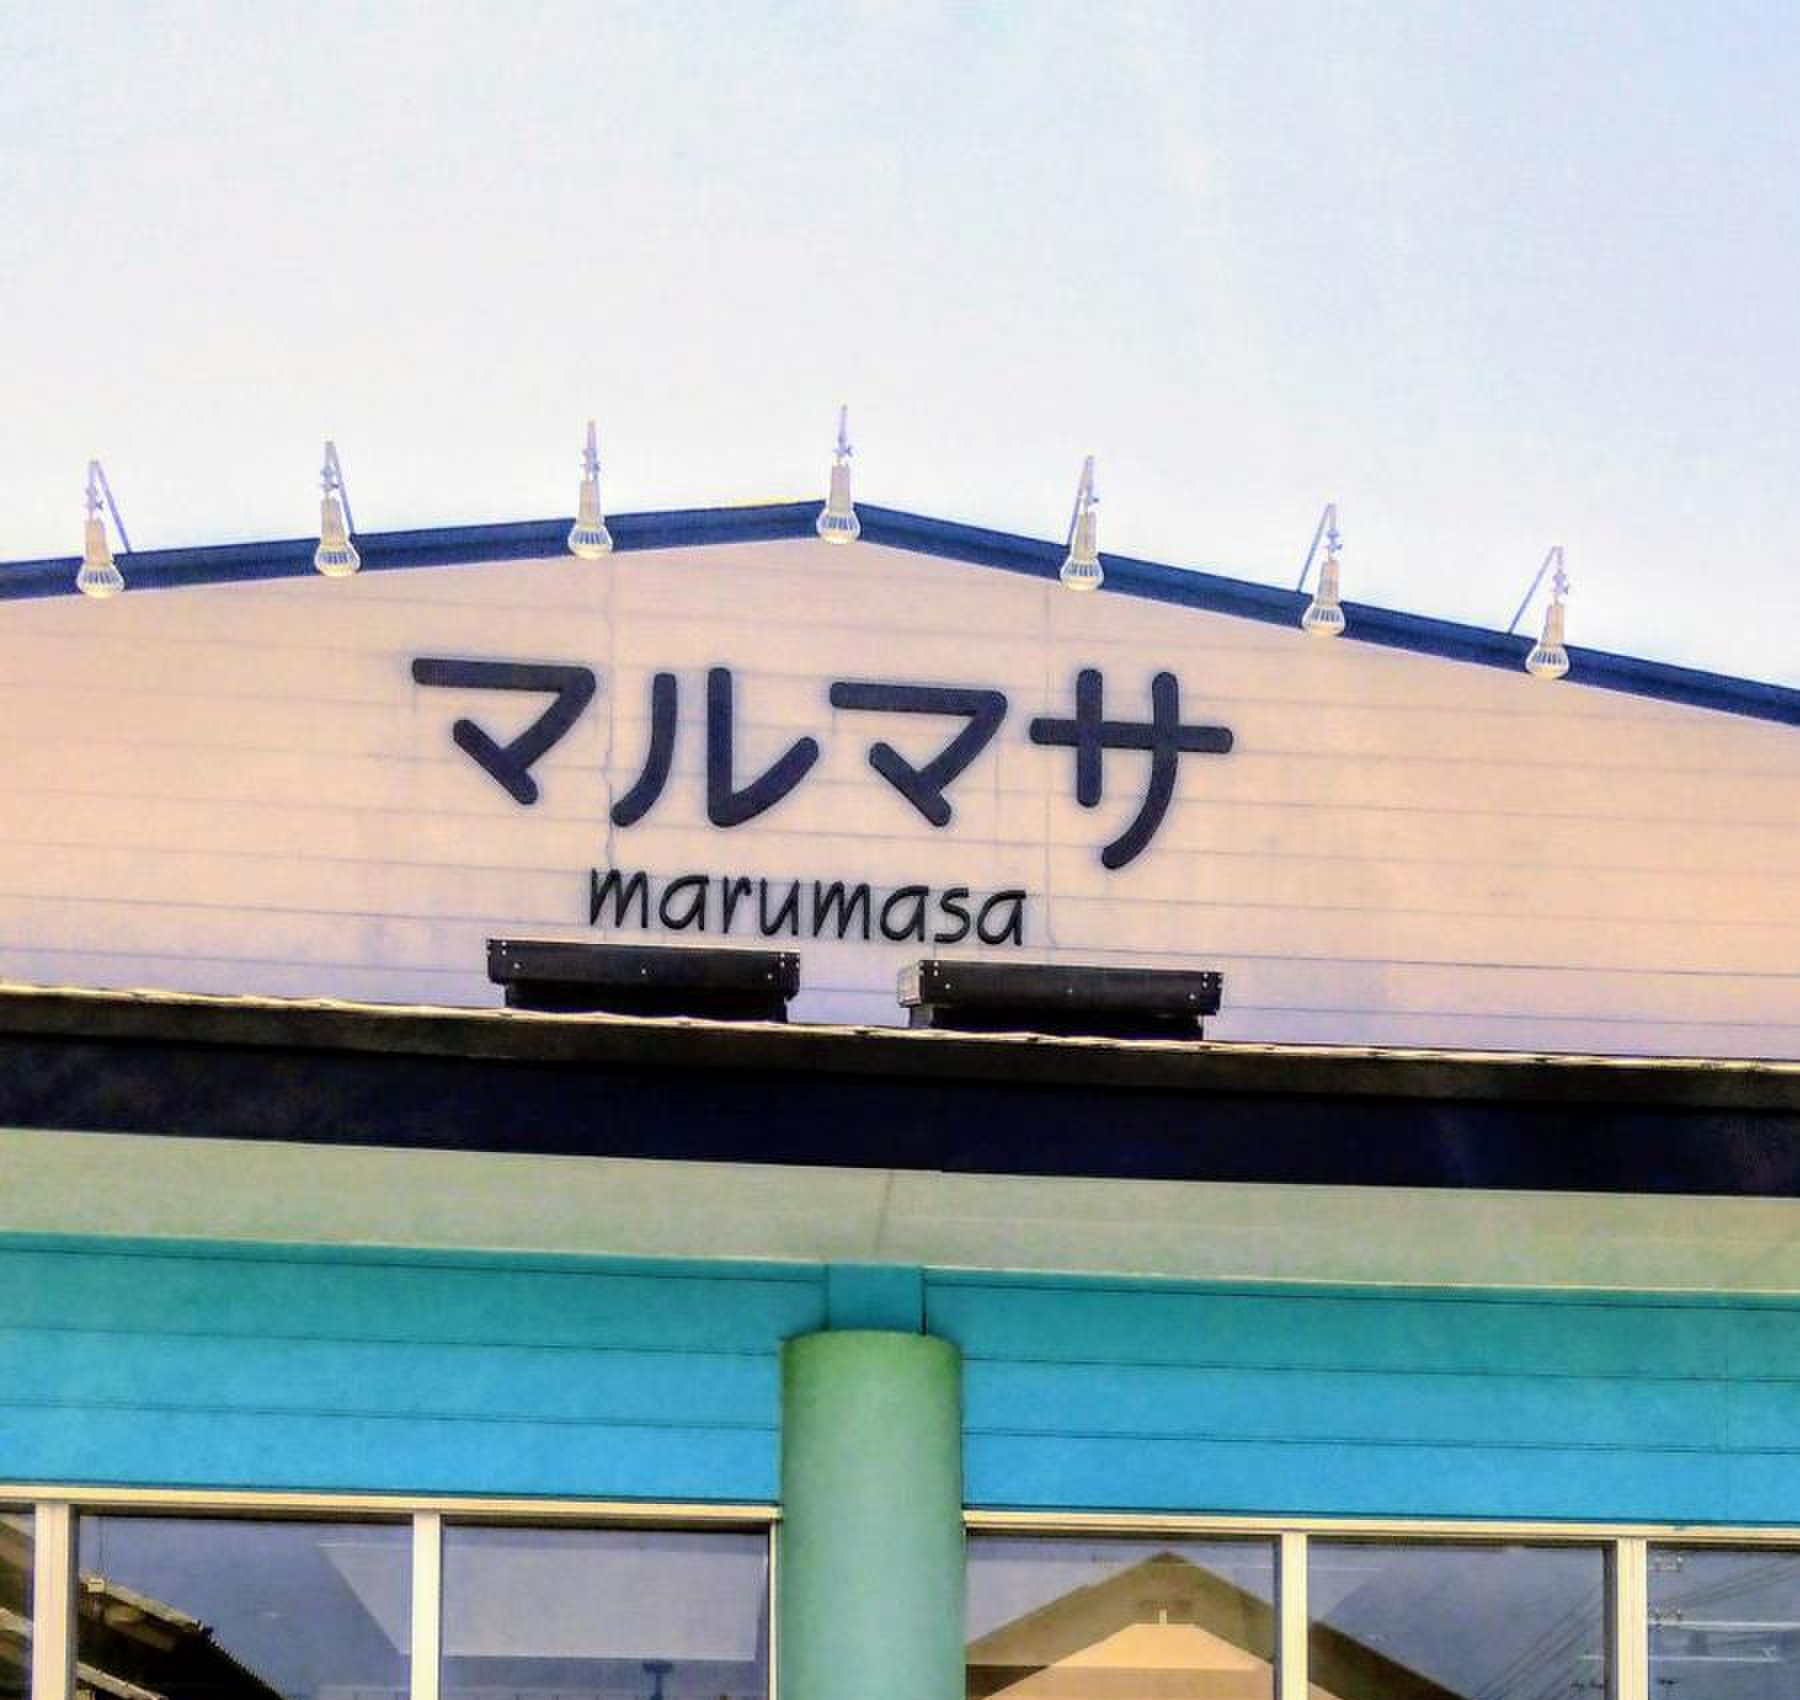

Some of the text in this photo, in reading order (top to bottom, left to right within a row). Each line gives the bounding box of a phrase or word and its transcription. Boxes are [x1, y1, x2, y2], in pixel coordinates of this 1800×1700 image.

[412, 657, 1233, 870] マルマサ
[588, 867, 1027, 947] marumasa
